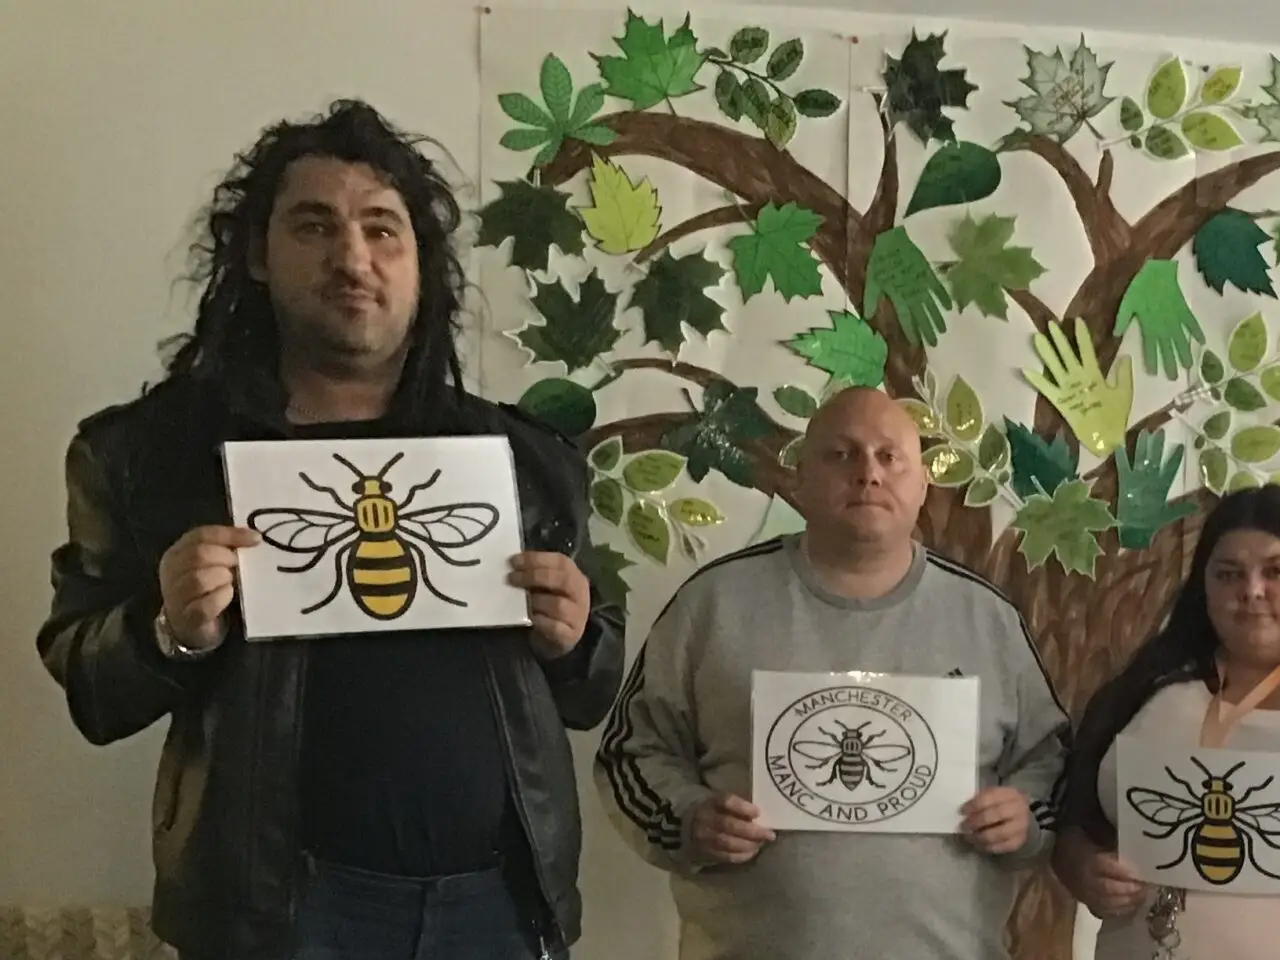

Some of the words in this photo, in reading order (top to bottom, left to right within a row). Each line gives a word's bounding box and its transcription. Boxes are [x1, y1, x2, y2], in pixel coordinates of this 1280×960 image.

[794, 690, 913, 722] MANCHESTER
[769, 754, 815, 808] MANC
[819, 803, 869, 822] AND
[876, 764, 932, 817] PROUD
